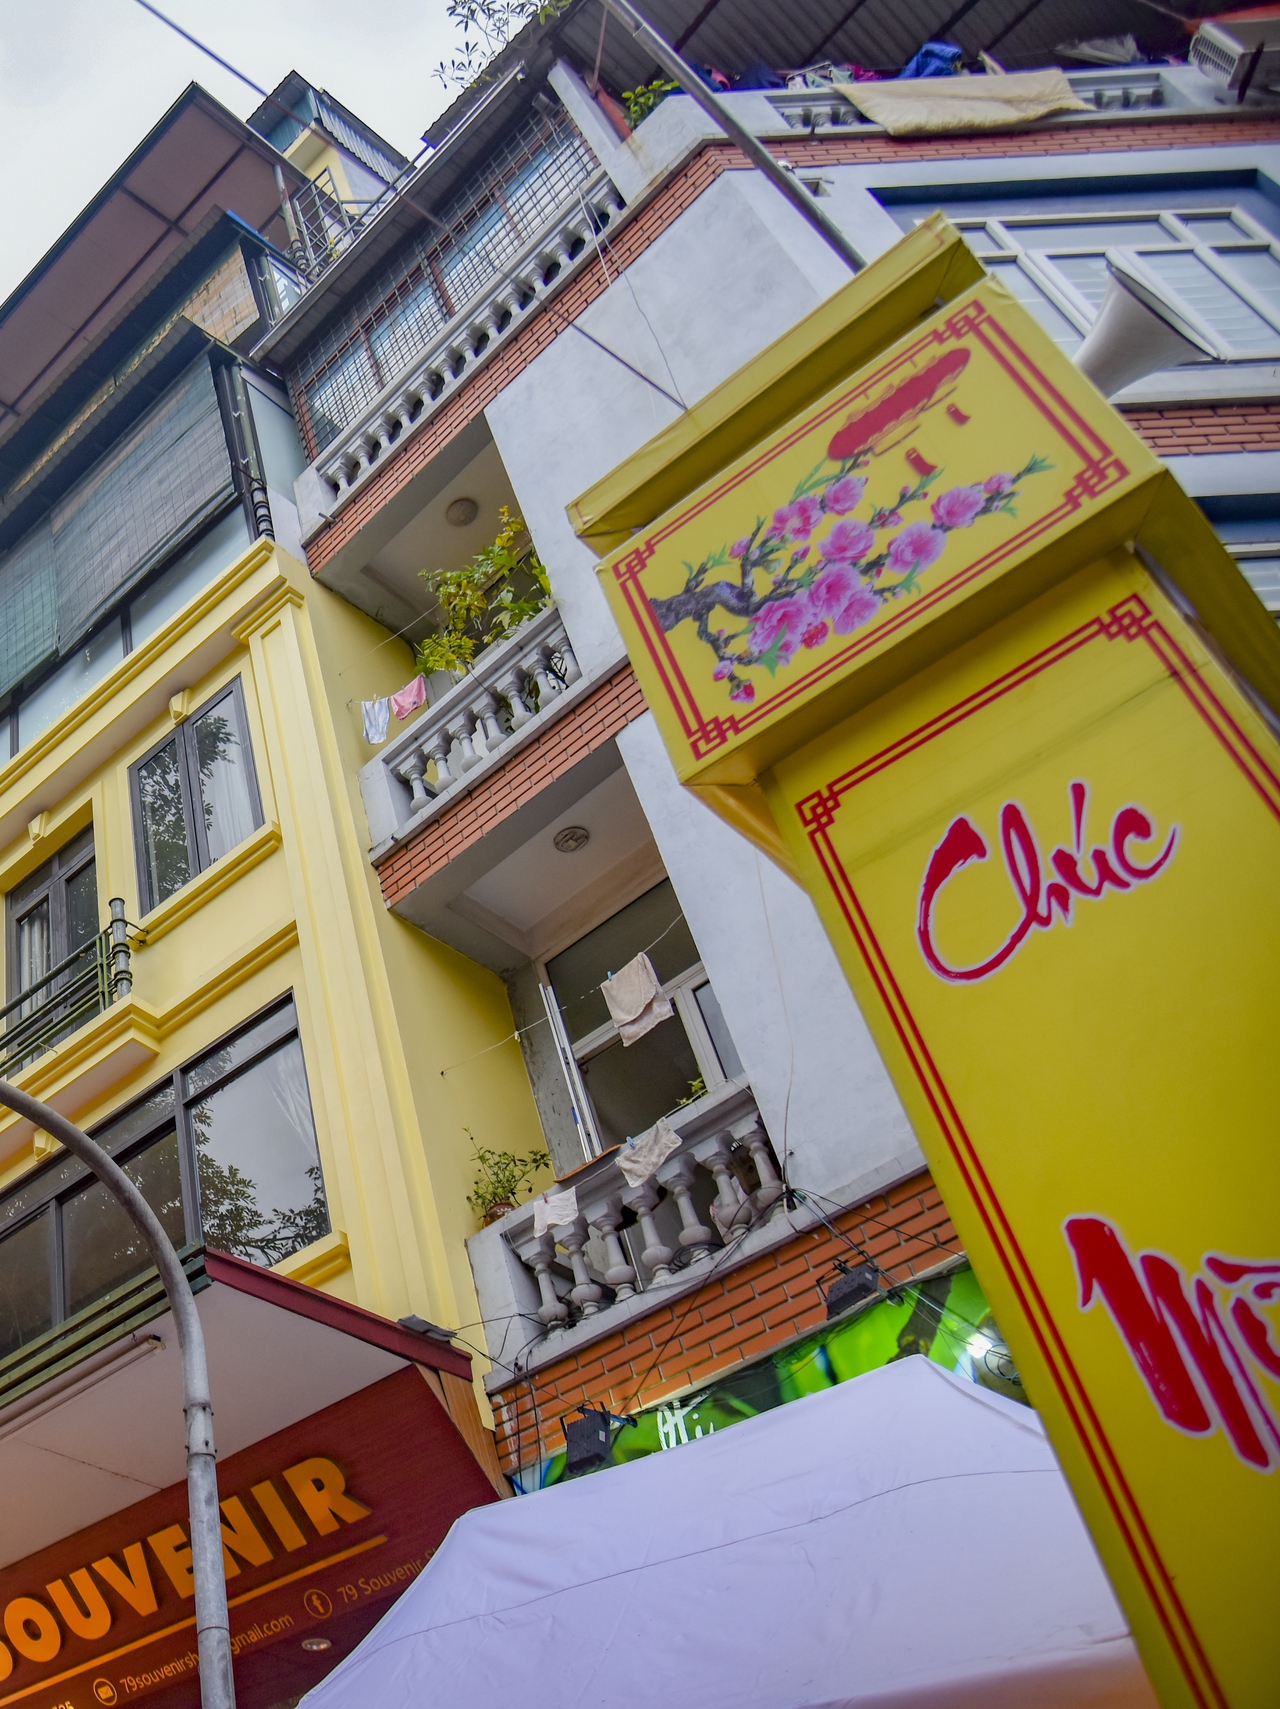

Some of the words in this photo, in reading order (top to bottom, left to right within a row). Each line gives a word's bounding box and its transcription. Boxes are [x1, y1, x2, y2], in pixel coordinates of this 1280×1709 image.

[918, 779, 1176, 982] Chúc
[336, 1583, 359, 1604] 79
[358, 1558, 423, 1595] Souvenir
